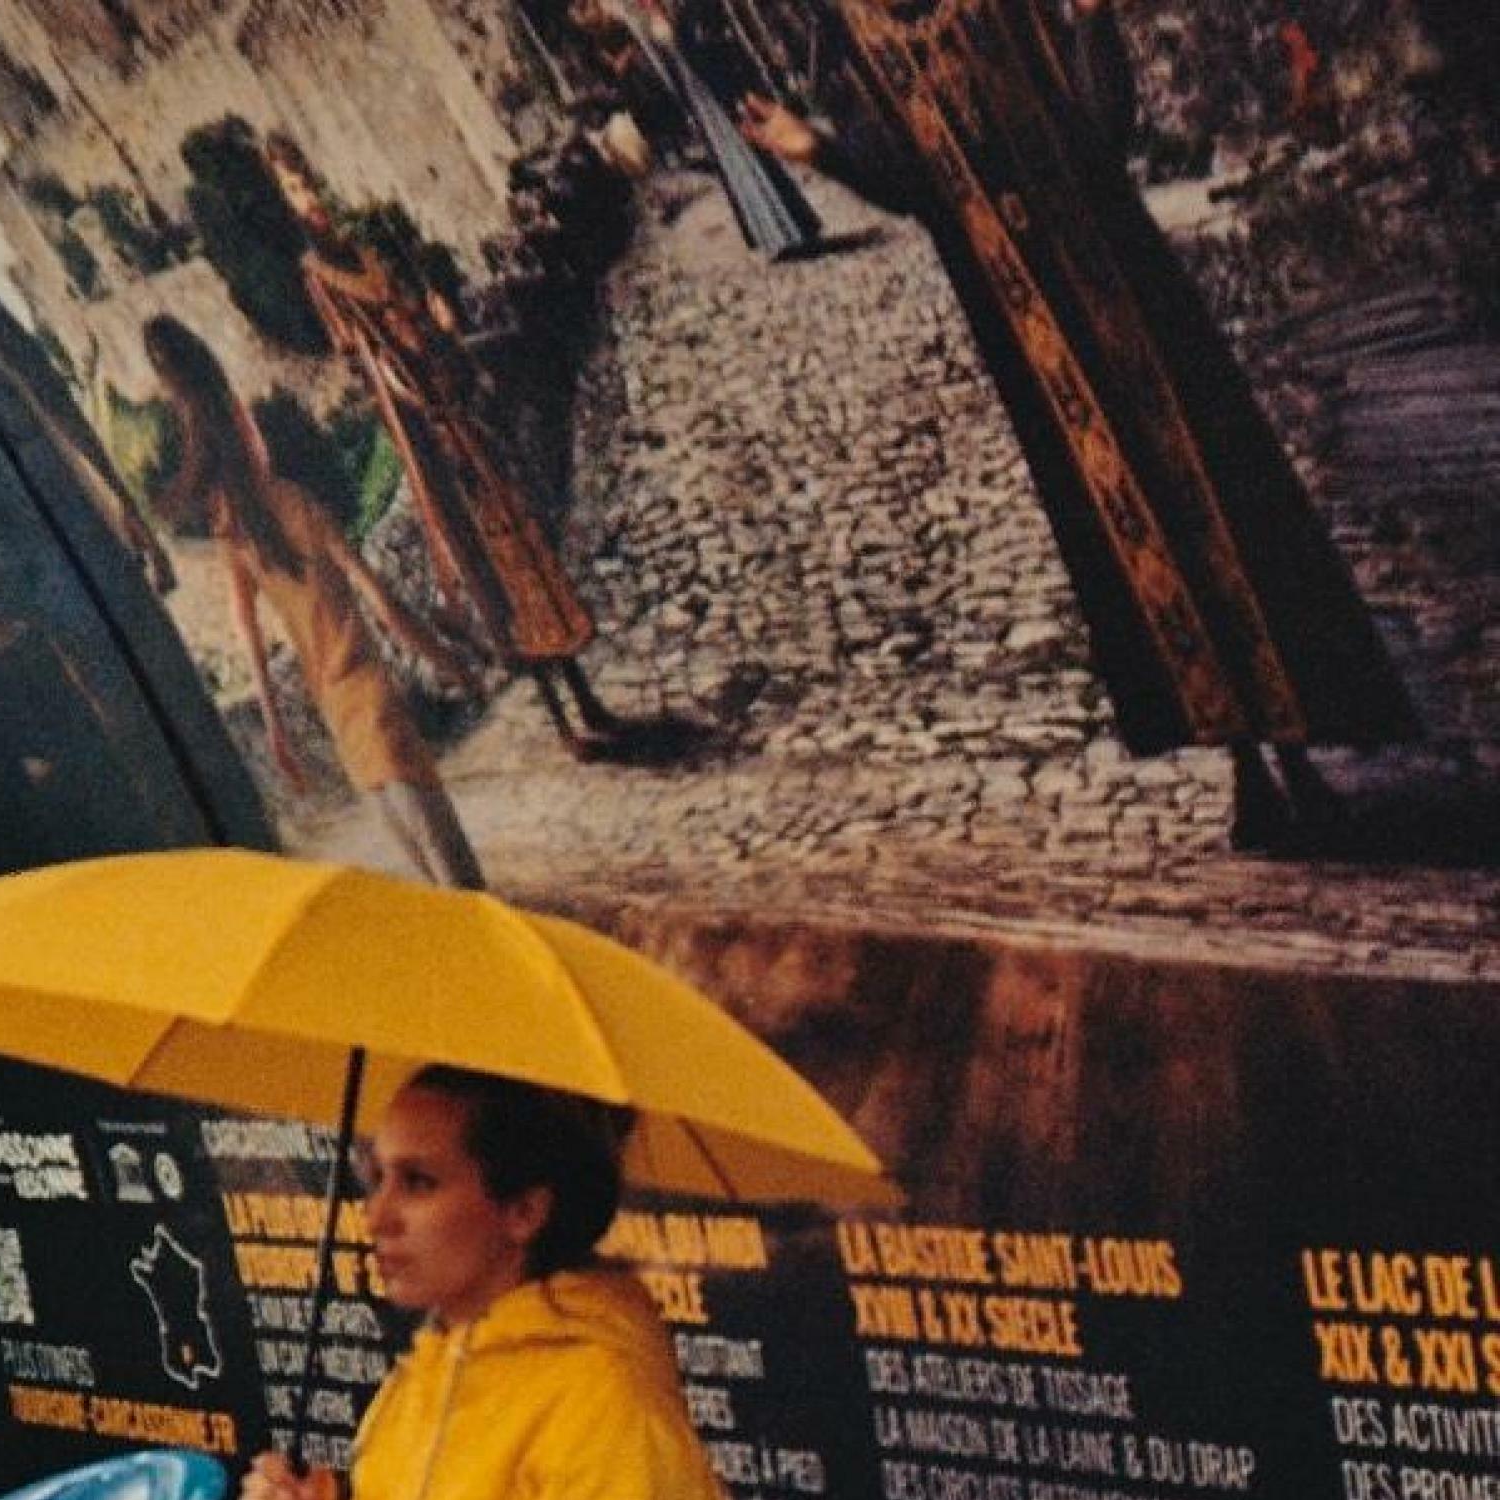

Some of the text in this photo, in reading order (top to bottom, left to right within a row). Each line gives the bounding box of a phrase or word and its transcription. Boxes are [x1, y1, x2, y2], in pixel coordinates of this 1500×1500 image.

[836, 1218, 1184, 1299] LA BASTIDE SAINT-LOUIS
[1302, 1247, 1348, 1312] LE
[1347, 1250, 1423, 1316] LAC
[1423, 1254, 1479, 1320] DE
[1313, 1320, 1378, 1385] XIX
[1380, 1324, 1411, 1388] &
[1413, 1327, 1479, 1393] XXI
[1331, 1395, 1388, 1449] DES
[1147, 1437, 1186, 1485] DU
[1189, 1441, 1257, 1491] DRAP
